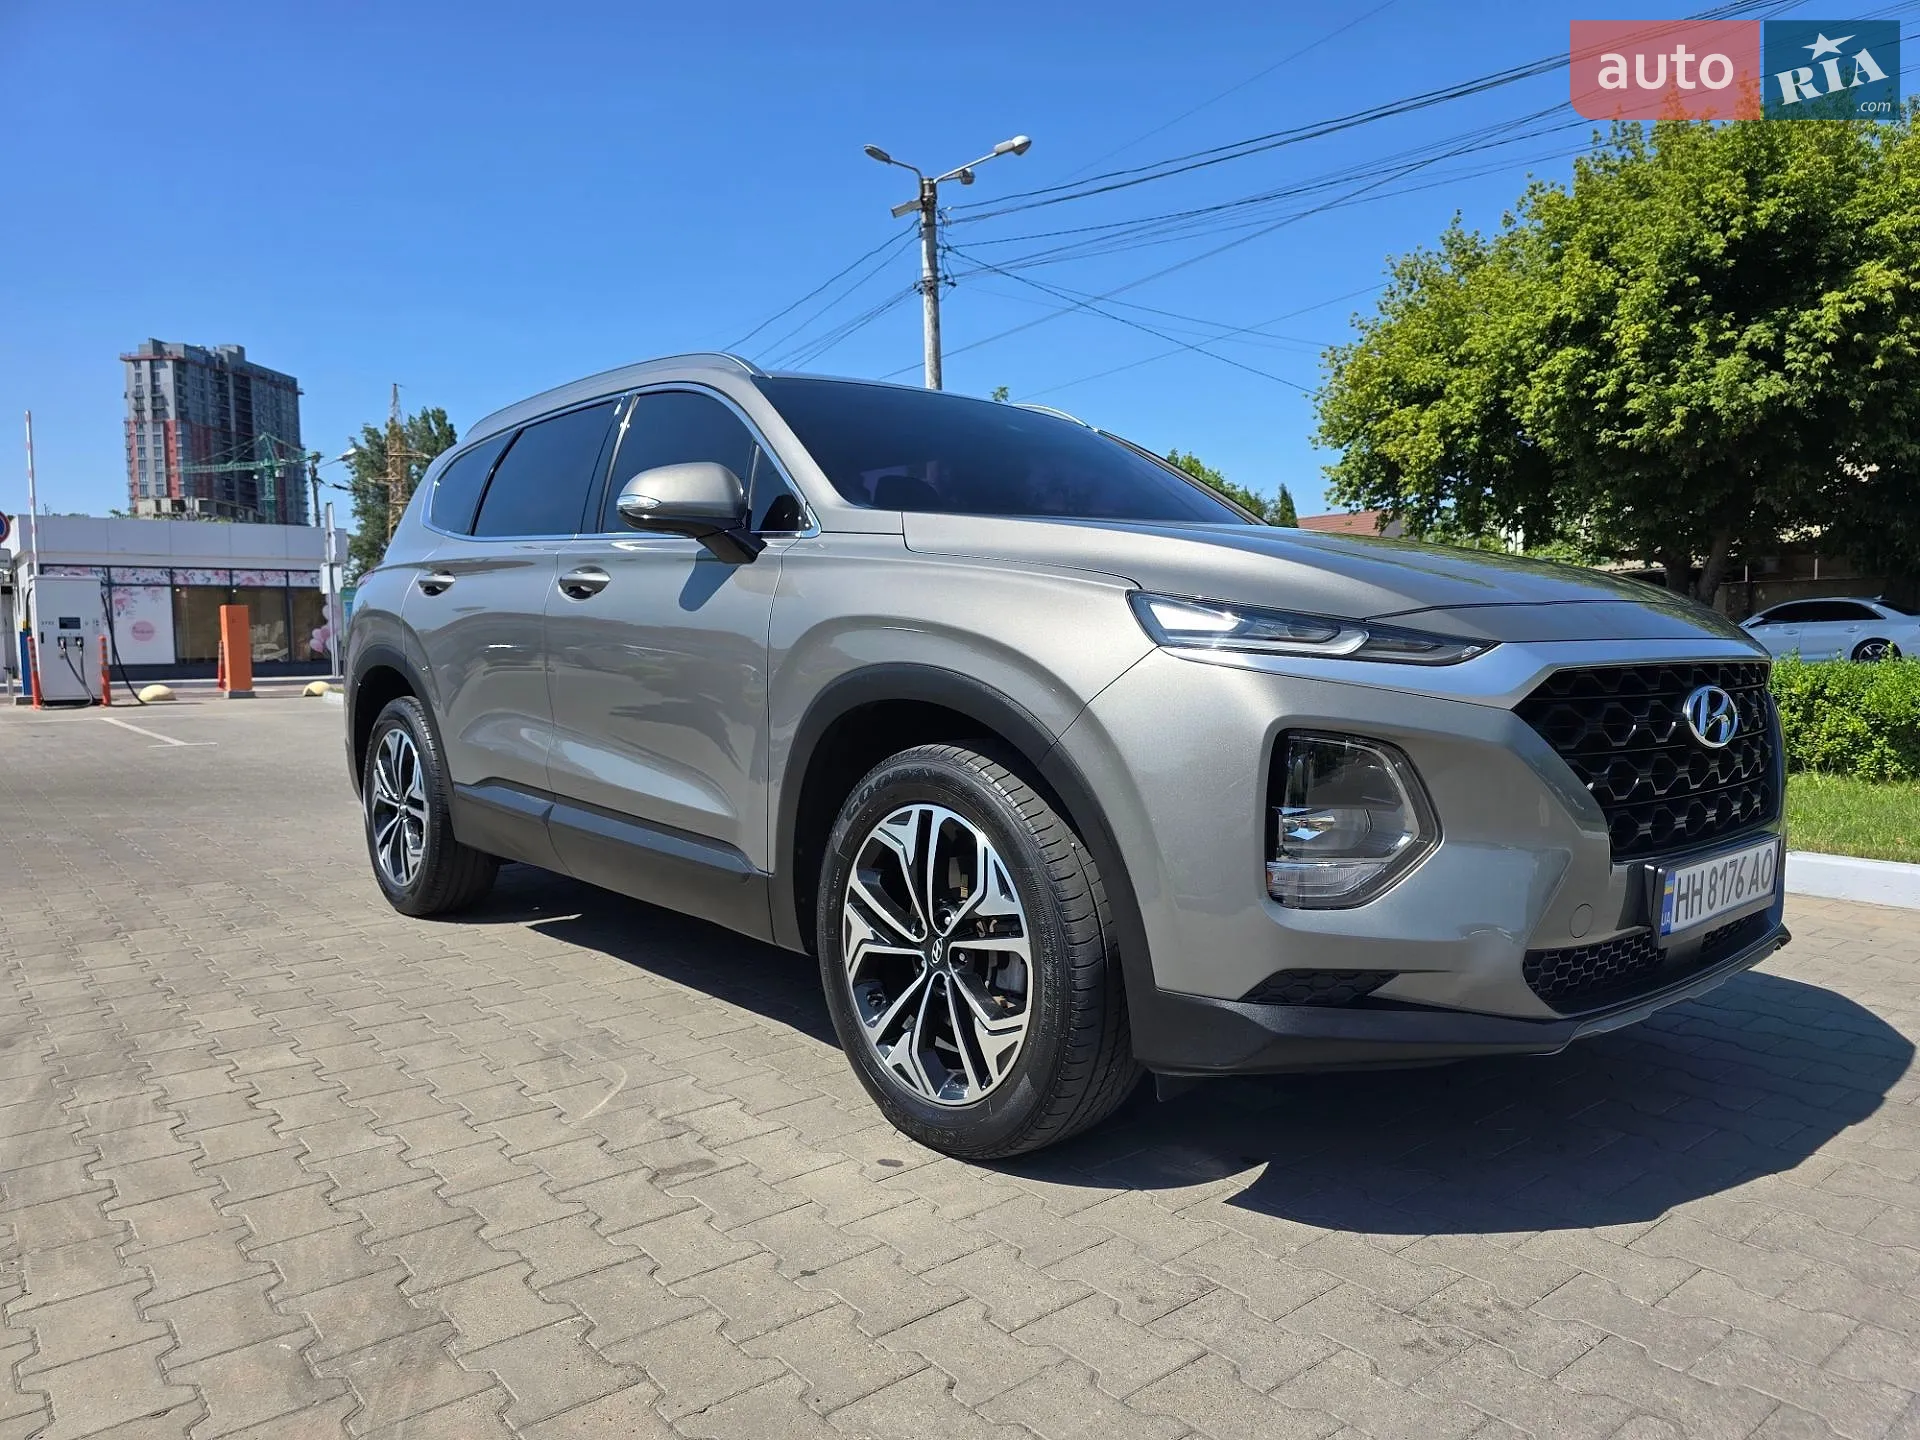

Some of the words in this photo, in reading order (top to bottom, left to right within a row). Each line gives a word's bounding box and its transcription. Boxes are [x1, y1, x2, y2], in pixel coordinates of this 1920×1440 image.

[1675, 870, 1705, 923] HH
[1707, 855, 1747, 910] 8176
[1748, 848, 1774, 897] AO
